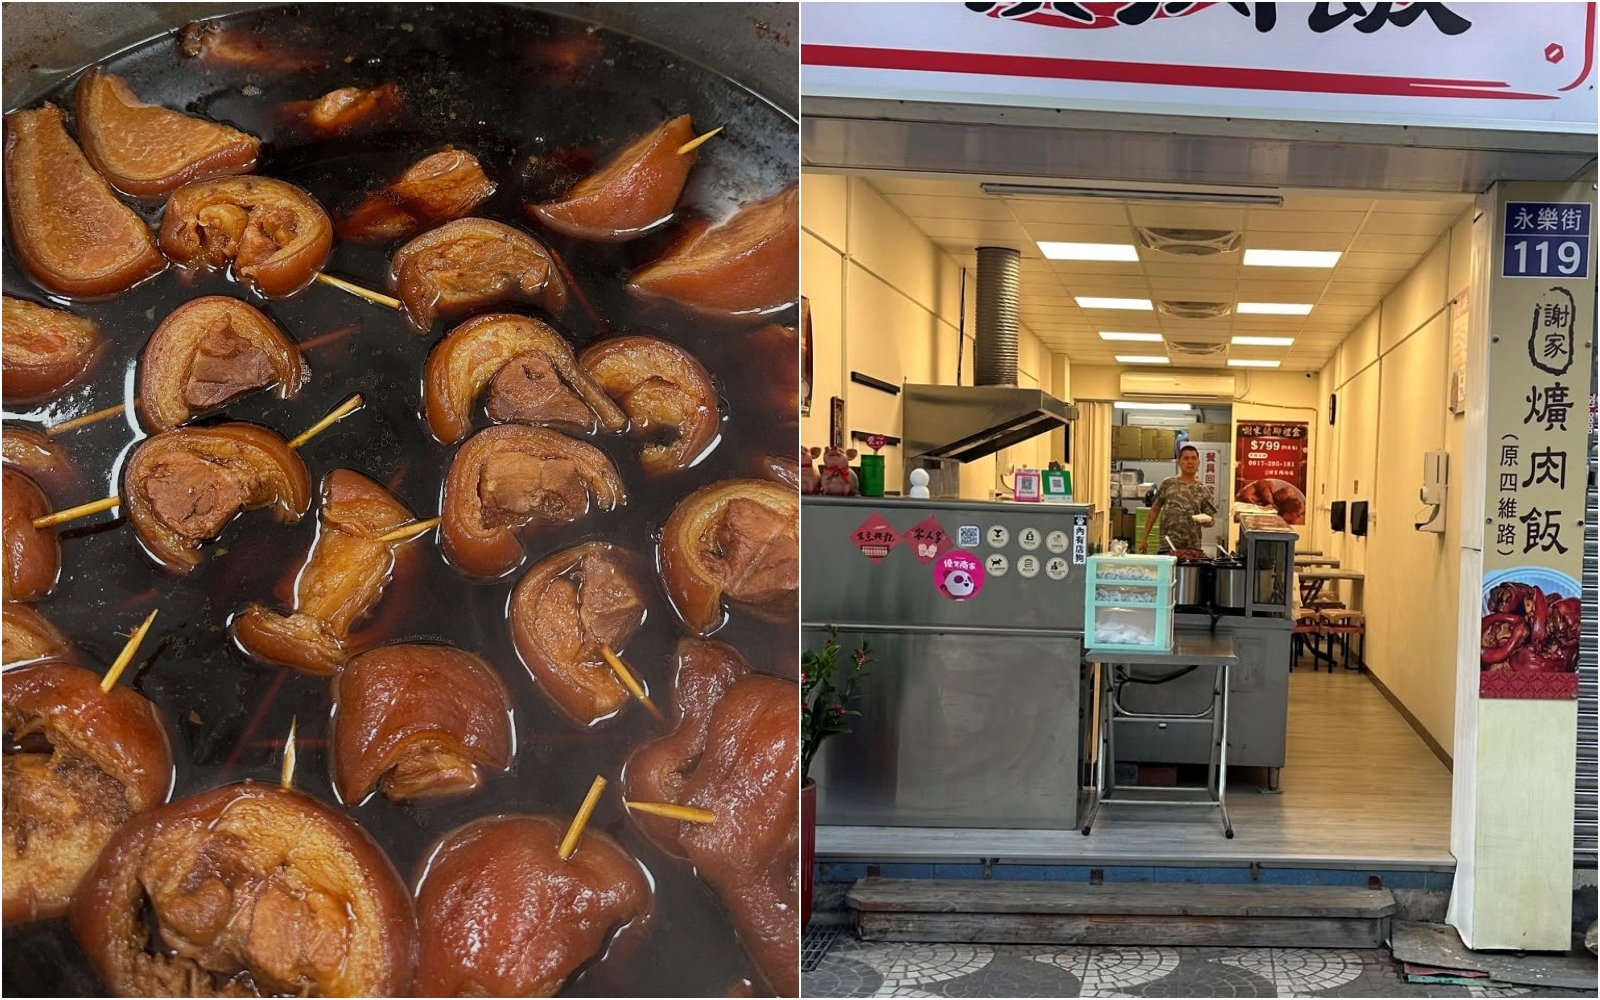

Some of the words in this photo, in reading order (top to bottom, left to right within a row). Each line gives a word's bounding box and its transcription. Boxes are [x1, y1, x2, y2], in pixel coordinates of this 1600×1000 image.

[1513, 207, 1582, 231] 永樂街
[1513, 241, 1581, 274] 119
[1543, 303, 1570, 358] 謝家
[1250, 440, 1280, 451] $799
[1519, 382, 1575, 555] 爌肉飯
[1075, 526, 1085, 563] 內有店狗
